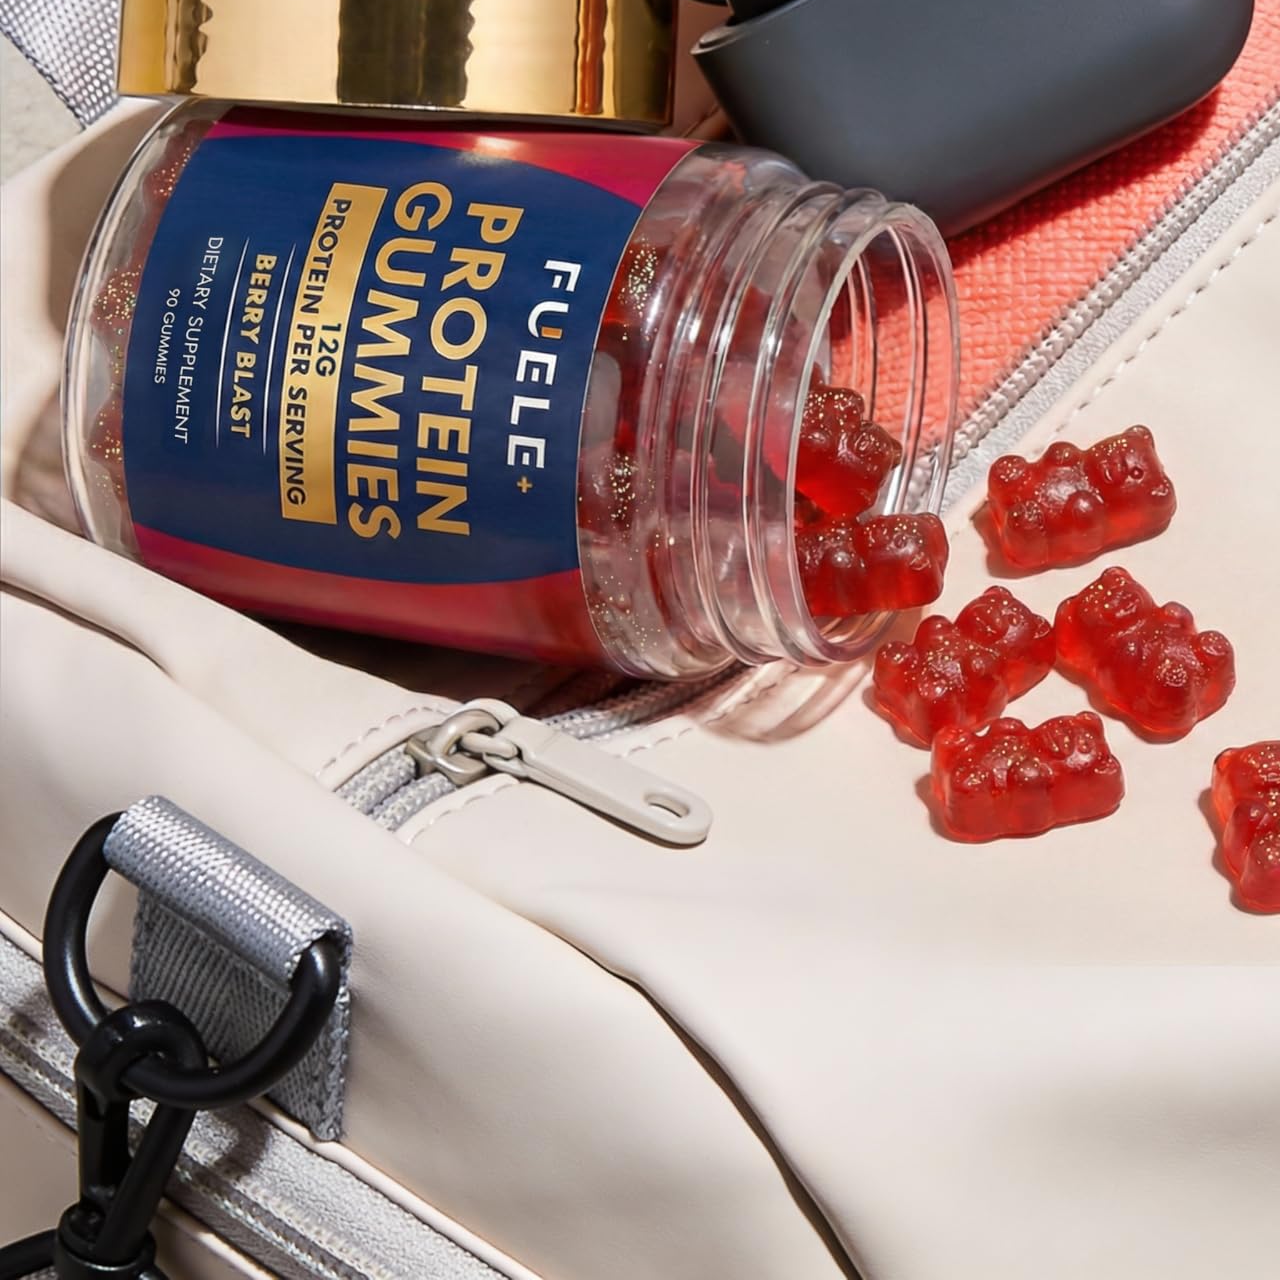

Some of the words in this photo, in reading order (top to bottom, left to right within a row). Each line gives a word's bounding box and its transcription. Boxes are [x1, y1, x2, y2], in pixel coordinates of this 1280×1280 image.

[165, 288, 181, 308] 90
[191, 236, 224, 314] DIETARY
[241, 252, 278, 345] BERRY
[299, 197, 352, 314] PROTEIN
[154, 310, 174, 384] GUMMIES
[173, 316, 203, 444] SUPPLEMENT
[289, 323, 316, 376] PER
[315, 322, 342, 377] 12G
[348, 181, 453, 539] GUMMIES
[416, 201, 525, 536] PROTEIN
[229, 351, 257, 438] BLAST
[285, 385, 307, 505] SERVING
